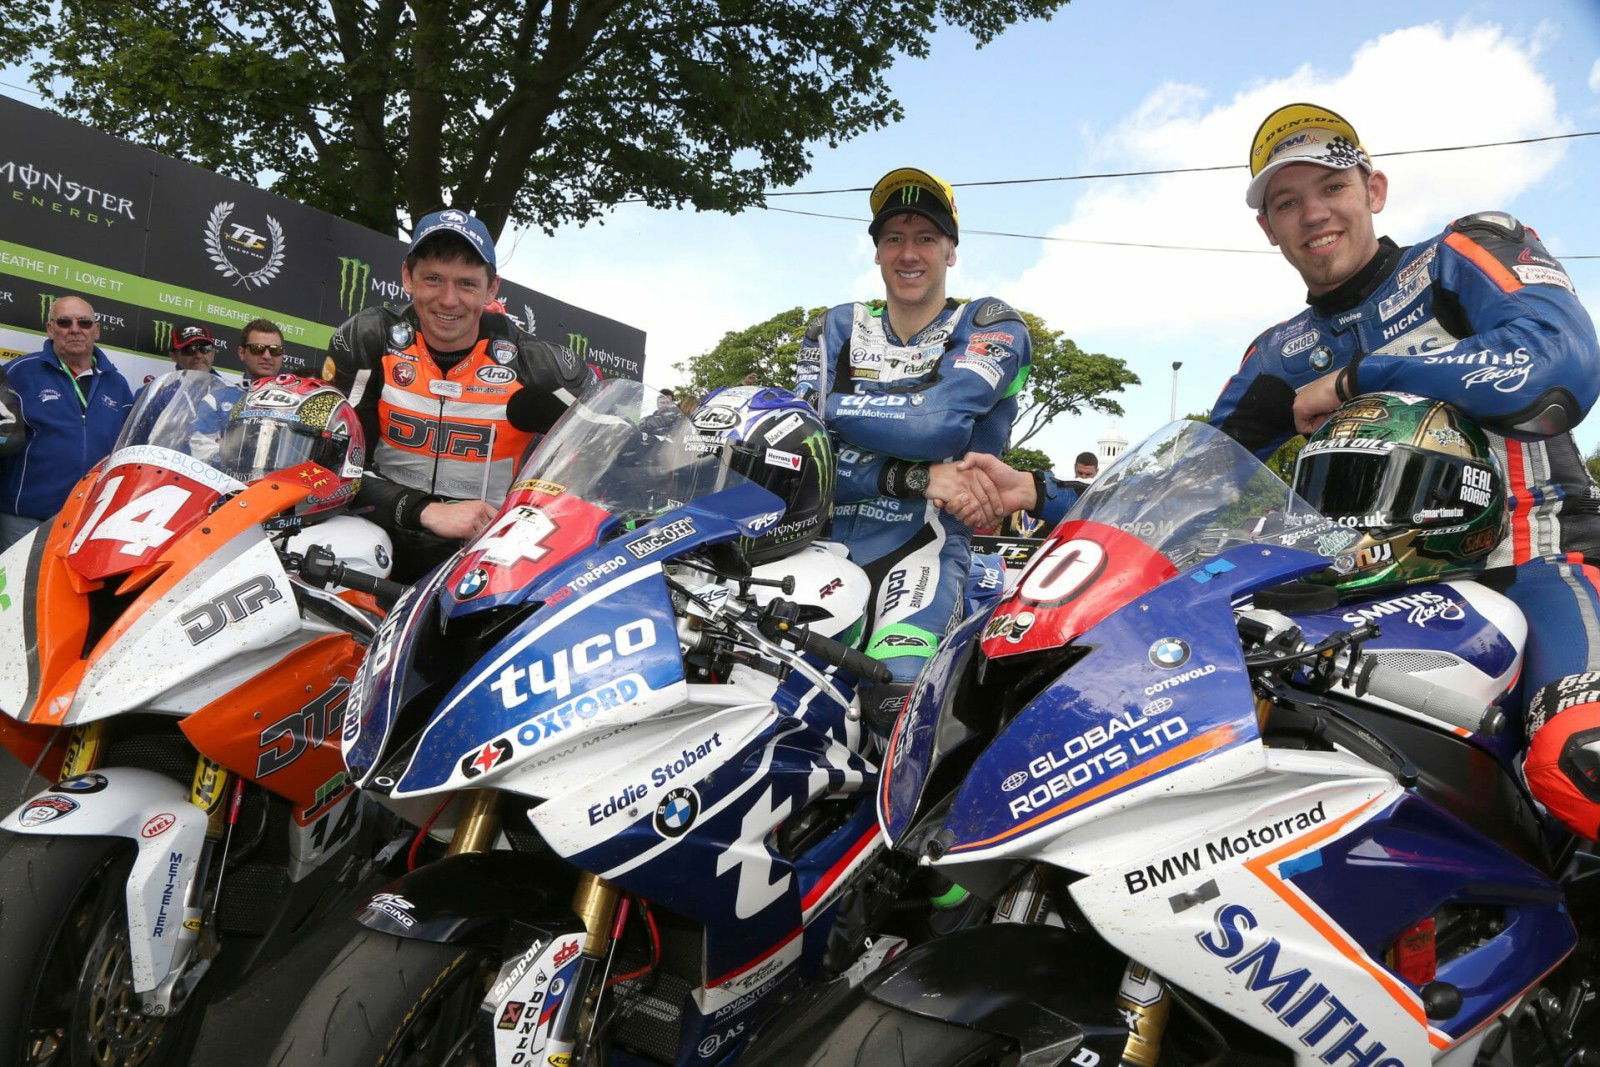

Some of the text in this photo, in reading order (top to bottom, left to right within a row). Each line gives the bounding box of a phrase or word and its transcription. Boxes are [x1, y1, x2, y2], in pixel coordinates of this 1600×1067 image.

[1266, 117, 1340, 142] DUNLOP
[12, 190, 114, 228] ENERGY
[0, 252, 123, 292] EATHE IT LOVE TT
[159, 292, 182, 306] LIVE
[184, 299, 194, 309] IT
[207, 304, 250, 322] BREATHE
[276, 321, 294, 334] OVE
[1383, 304, 1426, 340] HICKY
[1287, 333, 1317, 353] SHOEI
[1424, 348, 1530, 365] SMITHS
[480, 368, 510, 380] Arai
[589, 348, 638, 374] MONSTER
[1461, 363, 1534, 392] Racing
[694, 408, 737, 423] Arai
[836, 408, 906, 420] BMW Motorrad
[768, 452, 791, 463] Herrons
[1351, 438, 1396, 451] OILS
[172, 452, 232, 488] BLOOM
[1462, 465, 1492, 492] REAL
[1460, 486, 1491, 508] ROADS
[68, 475, 193, 557] 14
[277, 516, 302, 529] Billy
[766, 515, 818, 537] MONSTER
[468, 505, 556, 568] 4
[631, 521, 692, 557] Muc-Off
[996, 543, 1029, 560] TT
[819, 577, 844, 600] RR
[880, 569, 910, 618] tyco
[915, 566, 930, 592] Motorrad
[978, 568, 1003, 589] tyco
[1343, 591, 1446, 628] SMITHS
[1407, 597, 1466, 628] Racing
[490, 618, 656, 709] tyco
[1144, 664, 1217, 696] COTSWOLD
[517, 679, 639, 747] OXFORD
[1028, 711, 1149, 779] GLOBAL
[588, 731, 722, 827] Eddie Stobart
[1008, 716, 1189, 820] ROBOTS LTD
[148, 818, 170, 836] HEL
[1124, 801, 1326, 895] BMW Motorrad
[153, 852, 183, 938] METZELER
[367, 901, 414, 928] RACING
[511, 991, 544, 1065] DUNLO
